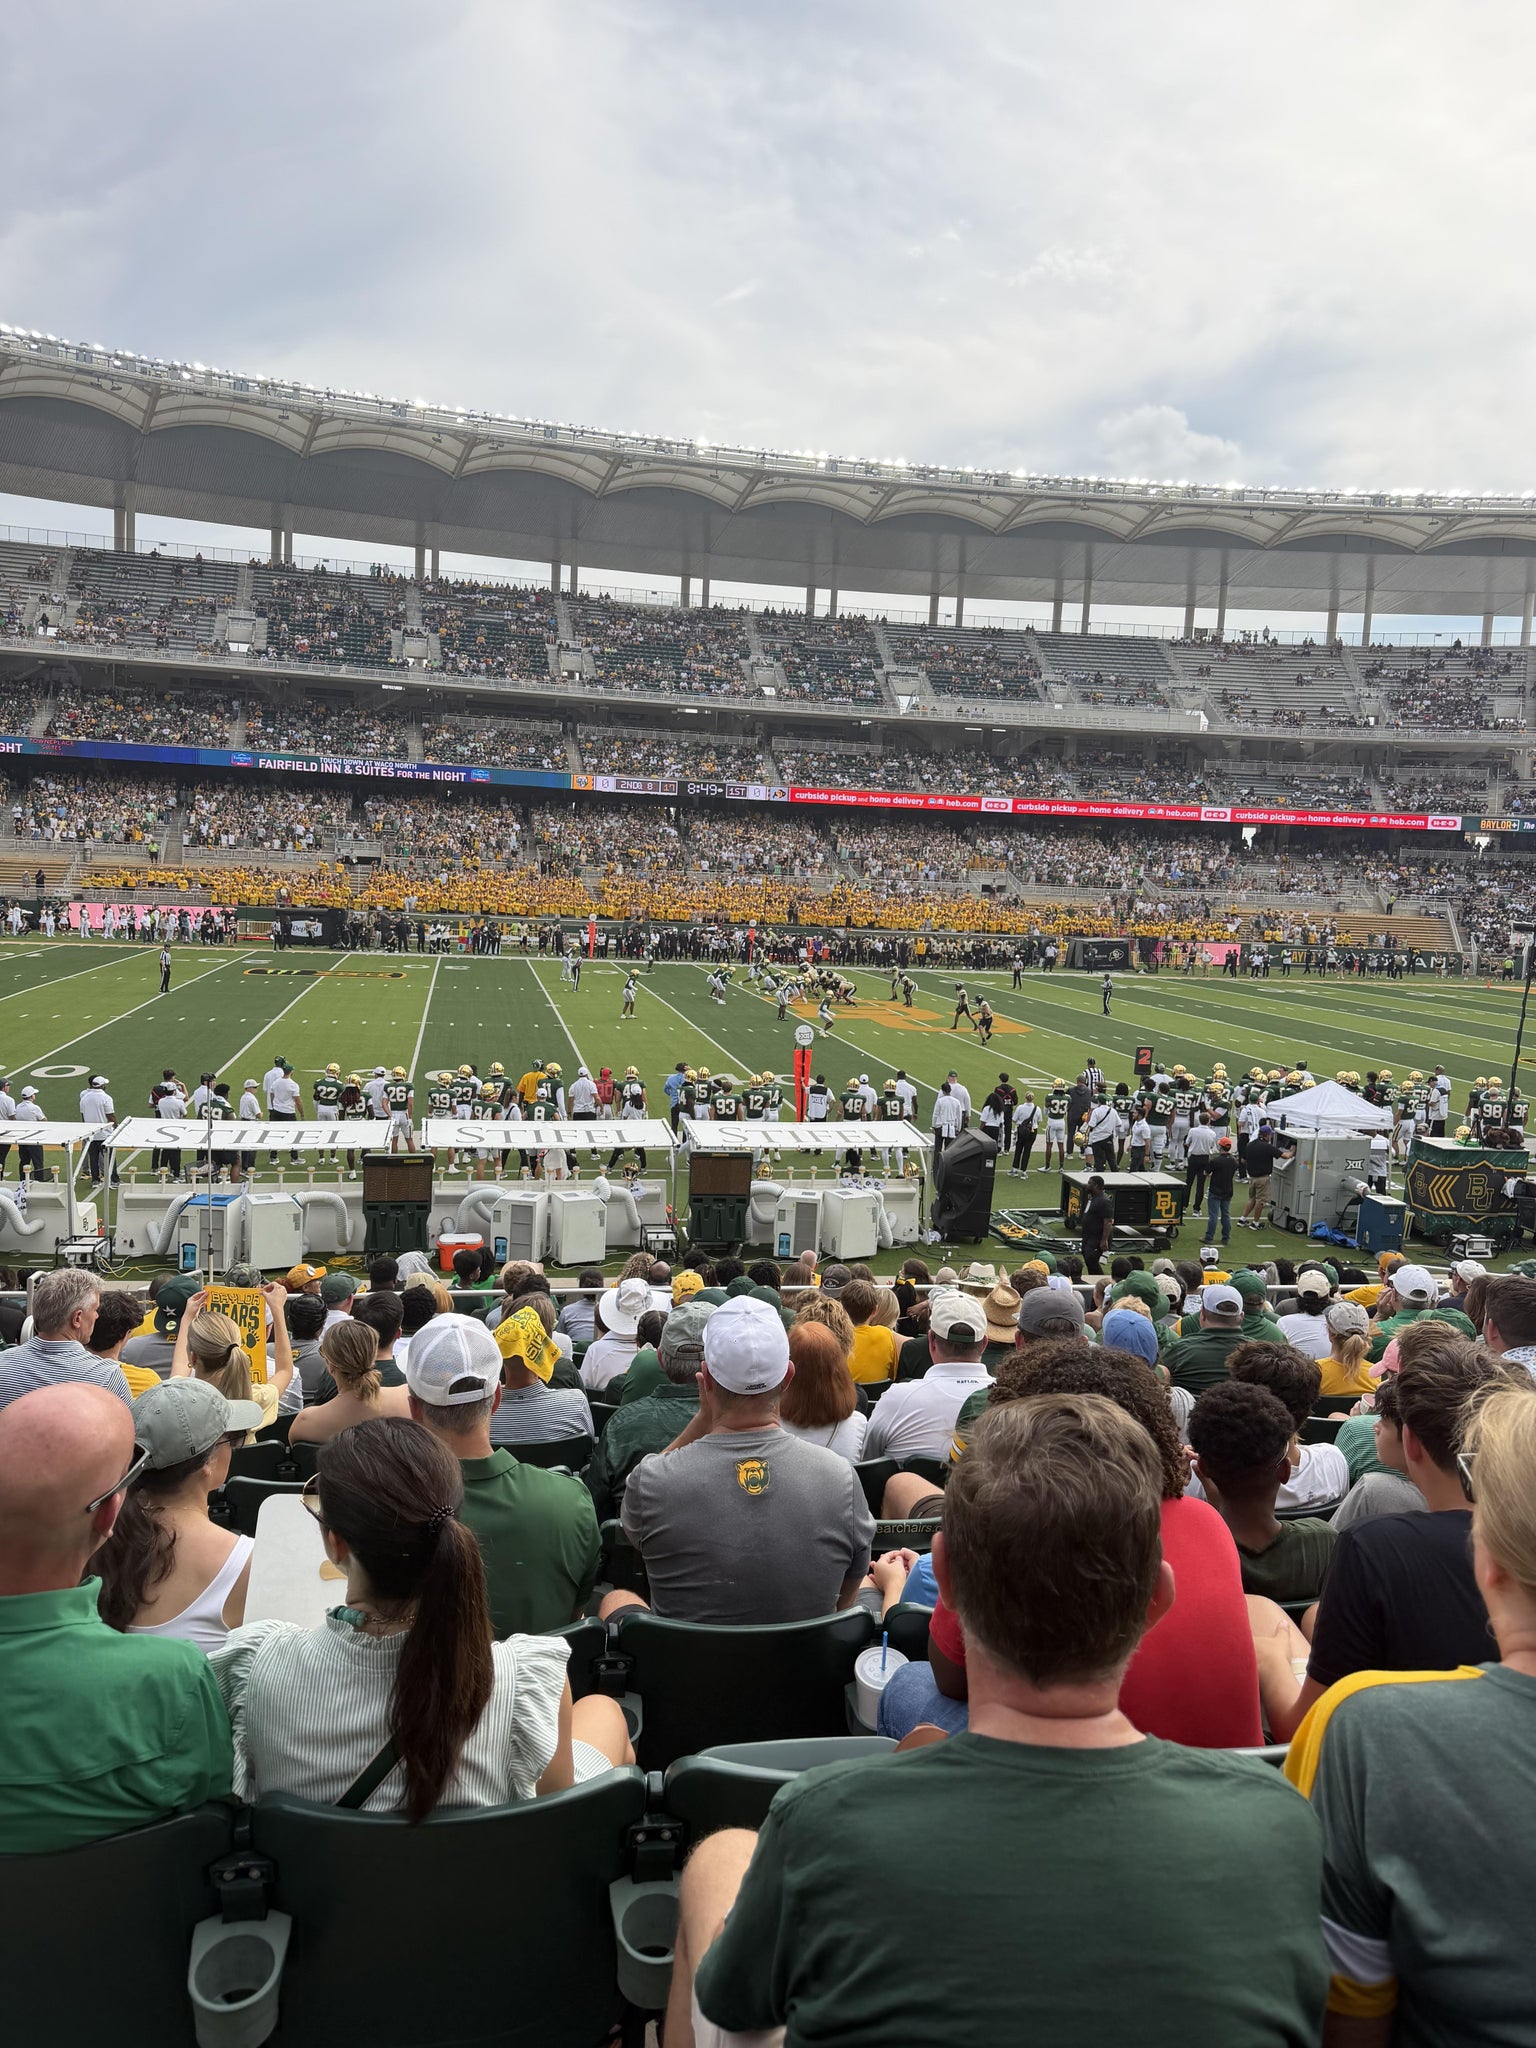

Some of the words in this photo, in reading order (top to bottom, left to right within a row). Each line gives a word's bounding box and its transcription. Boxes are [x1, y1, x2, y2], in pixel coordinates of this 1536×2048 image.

[259, 758, 318, 772] FAIRFIELD
[320, 763, 341, 774] INN
[344, 764, 353, 775] &
[355, 765, 394, 777] SUITES
[397, 770, 413, 778] FOR
[415, 771, 430, 779] THE
[433, 770, 467, 782] NIGHT
[343, 758, 364, 766] DOWN
[374, 761, 394, 769] WACO
[687, 782, 718, 795] 8:49
[729, 786, 746, 796] 1ST
[795, 791, 829, 800] curbside
[830, 794, 857, 804] pickup
[869, 795, 891, 804] home
[892, 796, 924, 806] delivery
[946, 799, 979, 808] heb.com
[1017, 803, 1050, 812] curbside
[1051, 804, 1078, 814] pickup
[1089, 805, 1112, 814] home
[1112, 806, 1144, 817] delivery
[1165, 809, 1198, 818] heb.com
[1235, 811, 1268, 821] curbside
[1270, 812, 1296, 823] pickup
[1308, 814, 1331, 824] home
[1333, 814, 1366, 825] delivery
[1389, 817, 1425, 827] heb.com
[1138, 1049, 1151, 1065] 2
[317, 1085, 338, 1100] 22
[387, 1086, 407, 1103] 26
[1175, 1092, 1195, 1109] 55
[430, 1093, 451, 1109] 39
[716, 1098, 736, 1115] 93
[749, 1094, 764, 1111] 12
[844, 1097, 864, 1114] 48
[885, 1100, 900, 1116] 19
[1050, 1099, 1069, 1114] 33
[1116, 1099, 1134, 1111] 37
[1155, 1098, 1174, 1116] 62
[474, 1106, 493, 1120] 94
[534, 1106, 546, 1121] 8
[1482, 1103, 1503, 1119] 98
[144, 1125, 358, 1145] STIFEL
[455, 1126, 646, 1144] STIFEL
[718, 1126, 898, 1144] STIFEL
[1345, 1159, 1365, 1171] XII
[1466, 1173, 1495, 1211] BU
[1155, 1191, 1177, 1218] BU
[211, 1291, 260, 1306] BAYLOR
